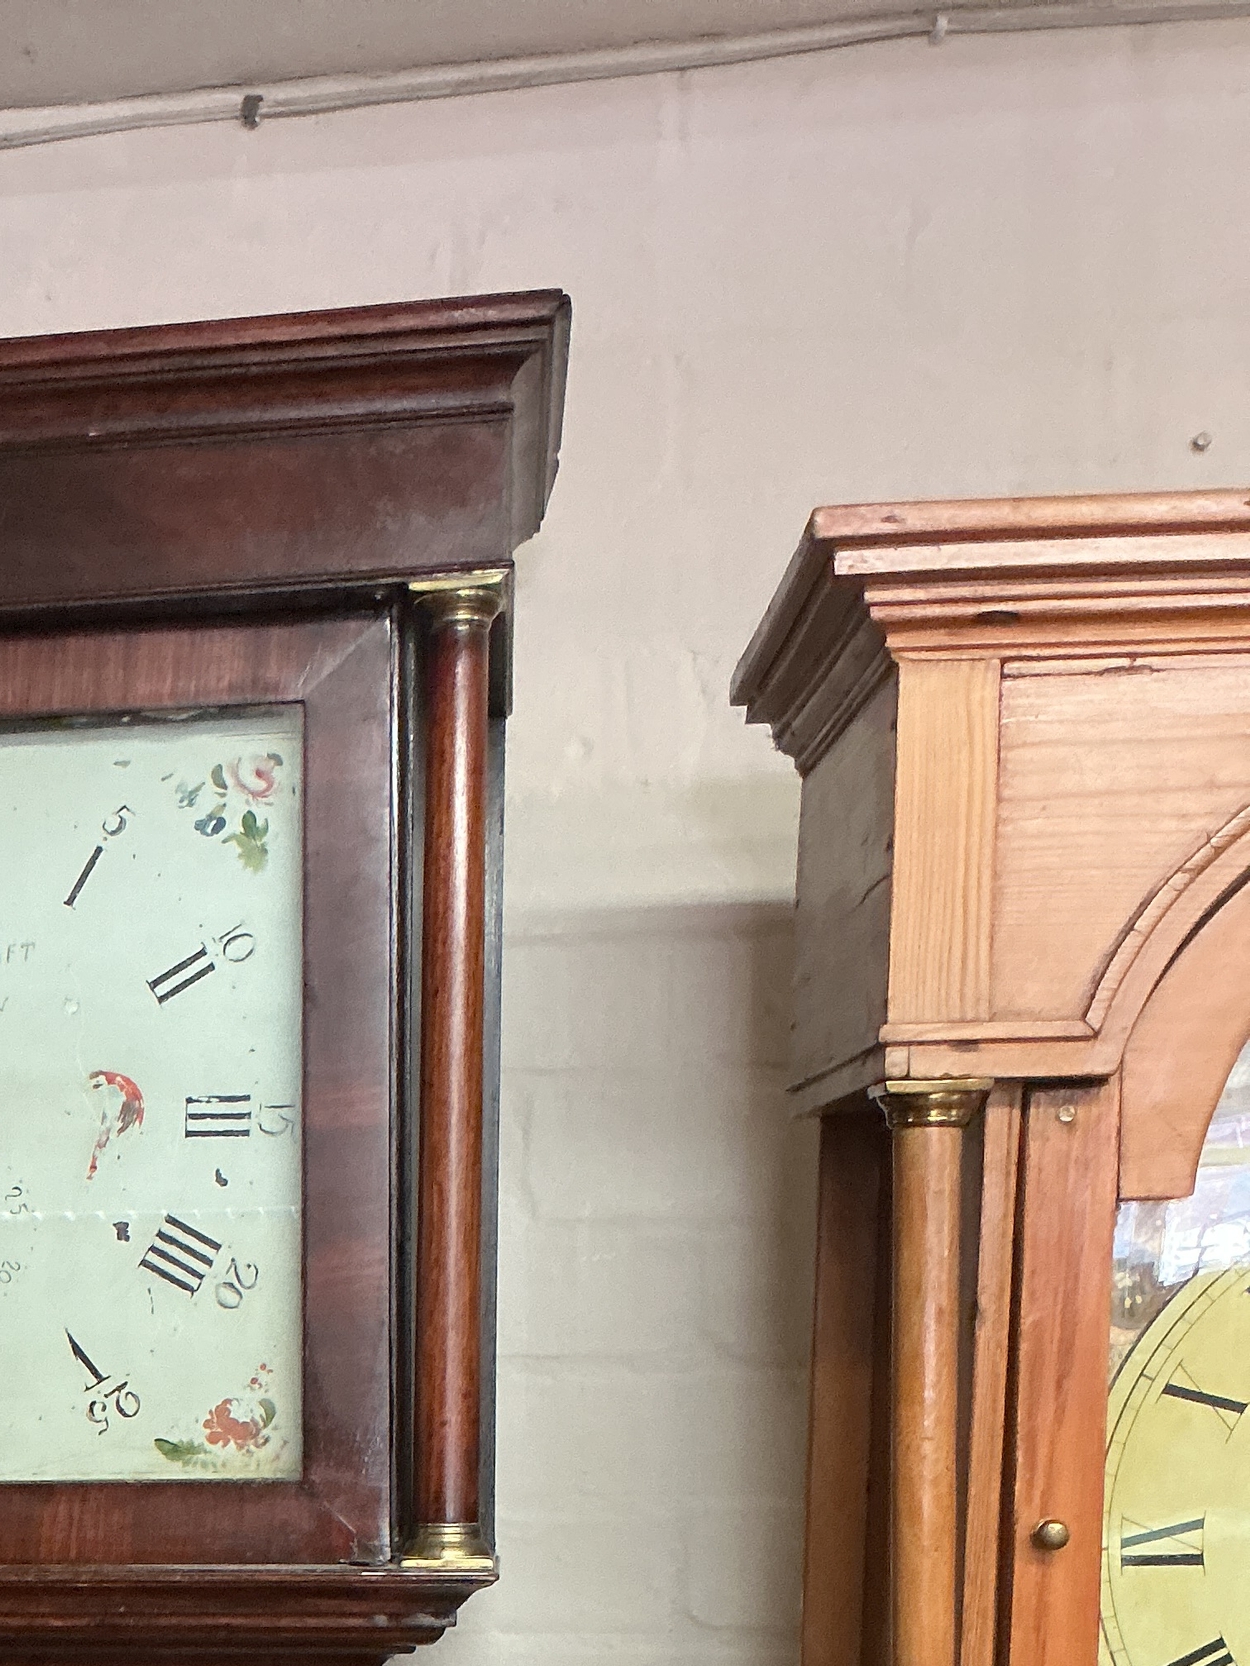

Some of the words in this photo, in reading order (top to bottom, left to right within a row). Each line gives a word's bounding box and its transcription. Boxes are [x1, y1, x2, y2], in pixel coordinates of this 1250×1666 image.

[102, 805, 136, 836] 5
[63, 845, 104, 910] I
[212, 920, 256, 962] 10
[146, 941, 216, 1006] II
[185, 1094, 251, 1138] III
[257, 1102, 297, 1142] 15
[215, 1256, 259, 1309] 20
[85, 1380, 141, 1436] 25
[1120, 1510, 1206, 1577] IX
